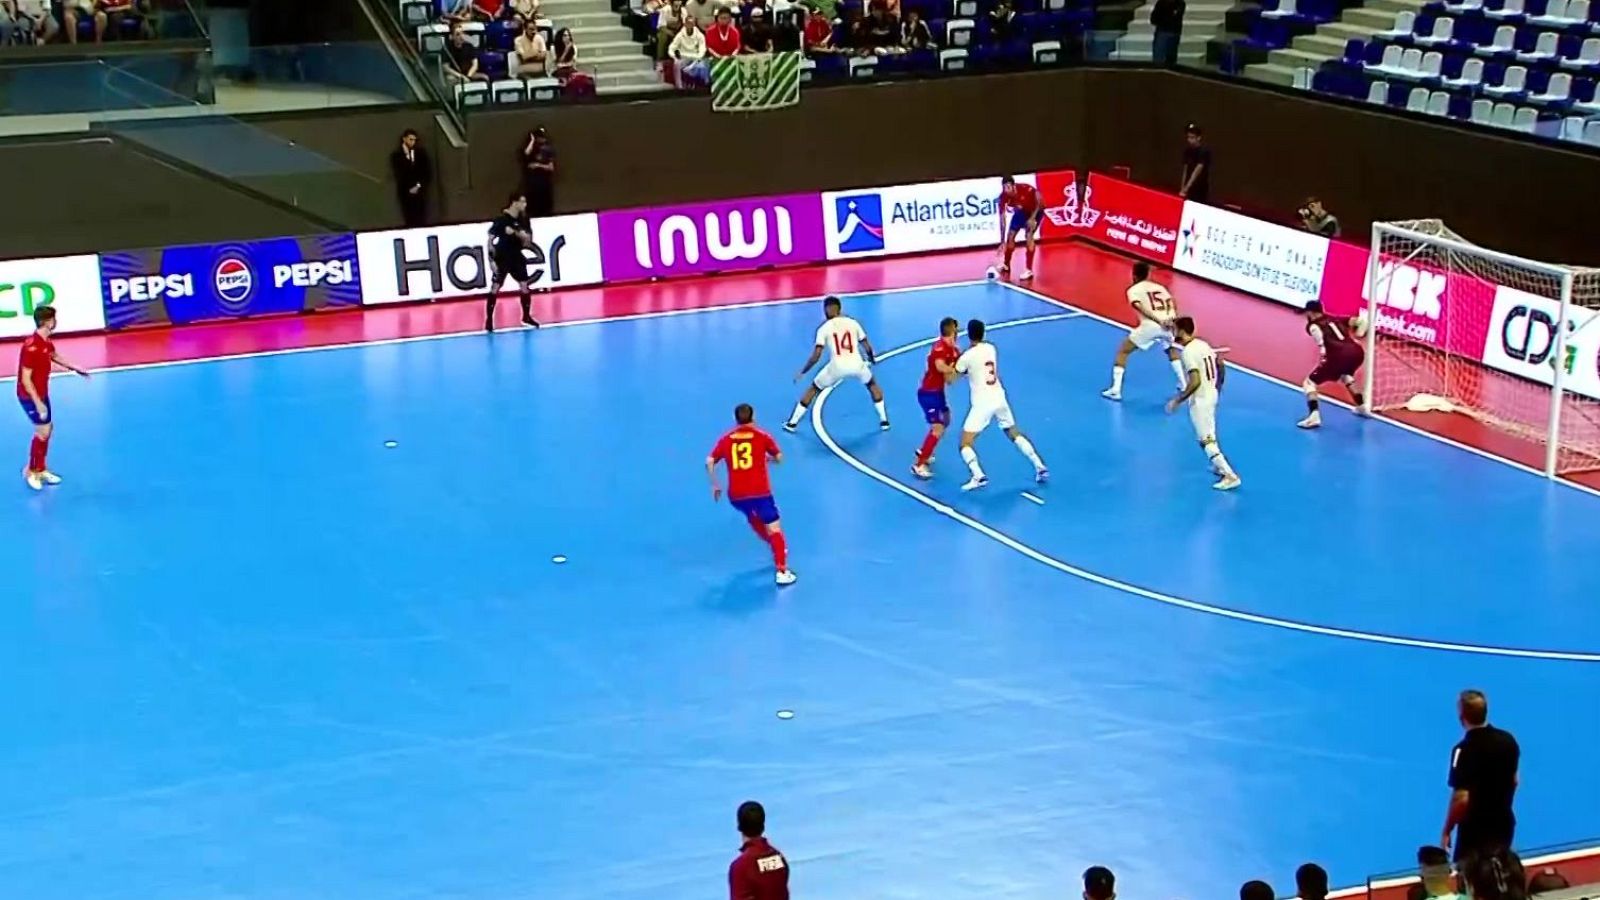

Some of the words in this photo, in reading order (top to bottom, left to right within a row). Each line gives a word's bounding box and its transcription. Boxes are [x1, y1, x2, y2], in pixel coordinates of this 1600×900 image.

[891, 194, 1000, 224] AtlantaSa
[273, 260, 353, 288] PEPSI
[393, 234, 566, 296] Haer
[110, 273, 193, 303] PEPSI
[1147, 292, 1165, 311] 15
[833, 331, 853, 355] 14
[1328, 321, 1344, 340] 1
[985, 361, 996, 386] 3
[1203, 355, 1215, 381] 11
[732, 442, 753, 470] 13
